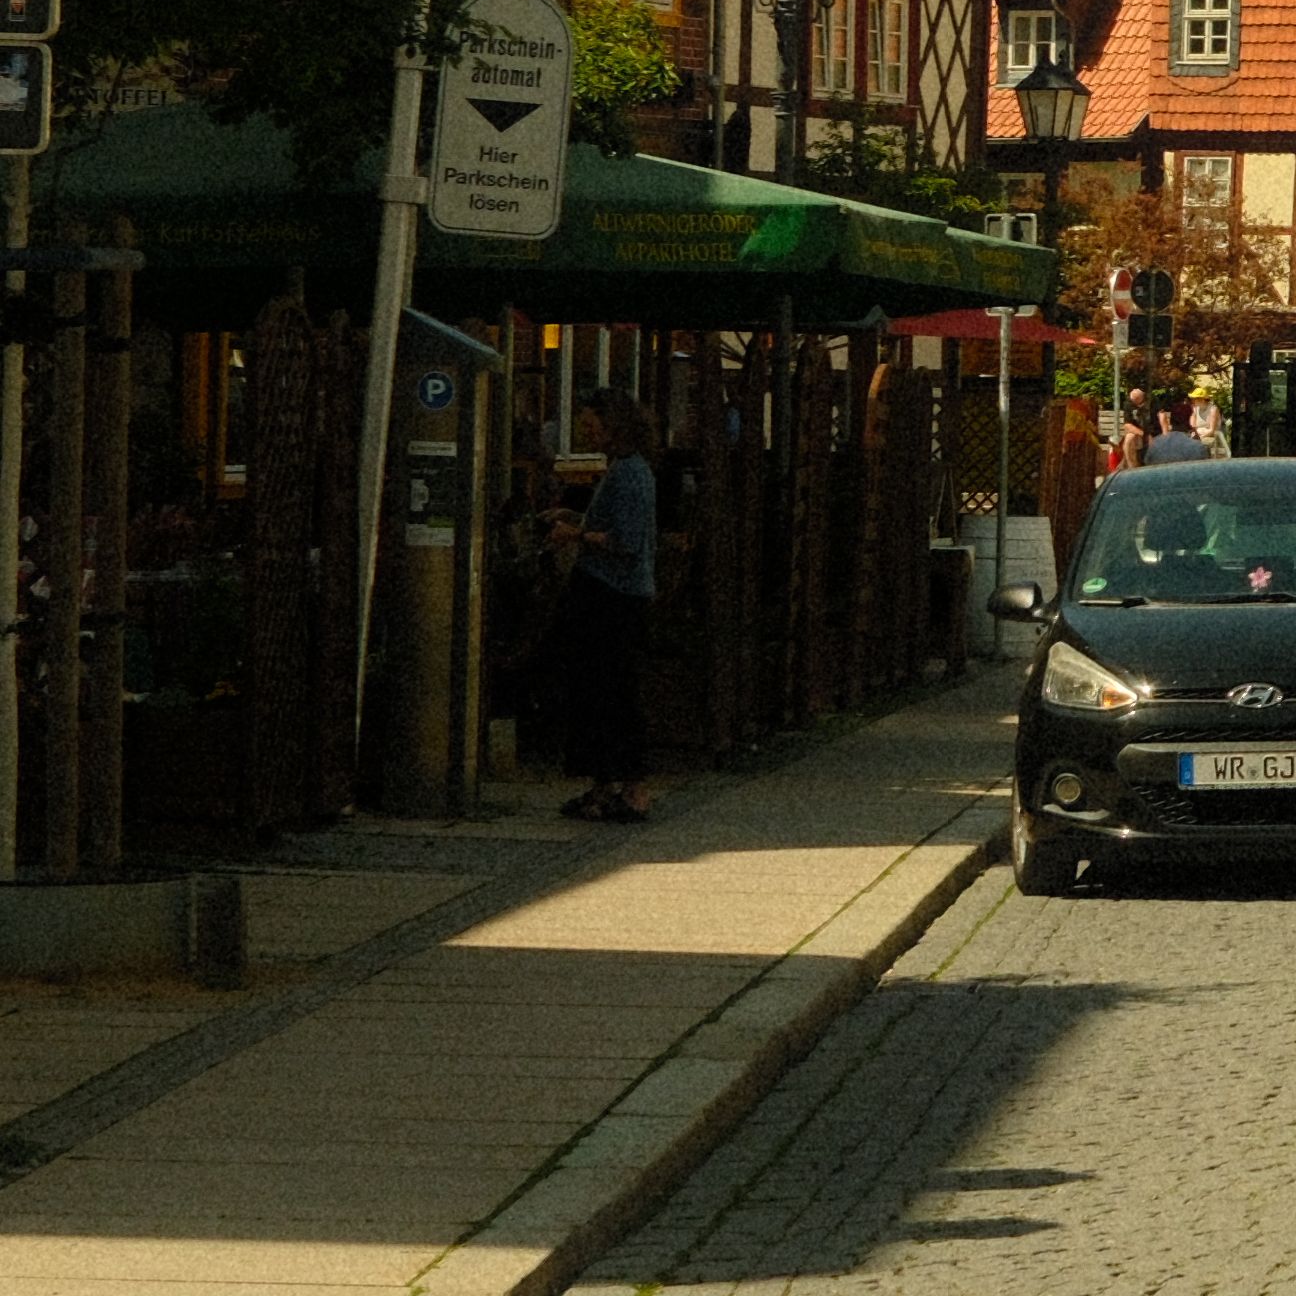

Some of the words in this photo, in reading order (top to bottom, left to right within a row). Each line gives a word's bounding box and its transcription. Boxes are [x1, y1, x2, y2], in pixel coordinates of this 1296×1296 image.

[459, 30, 563, 60] Parkschein-
[471, 65, 543, 88] automat
[479, 145, 519, 164] Hier
[443, 167, 549, 191] Parkschein
[469, 193, 520, 213] lösen
[426, 379, 446, 402] P
[1214, 756, 1244, 779] WR
